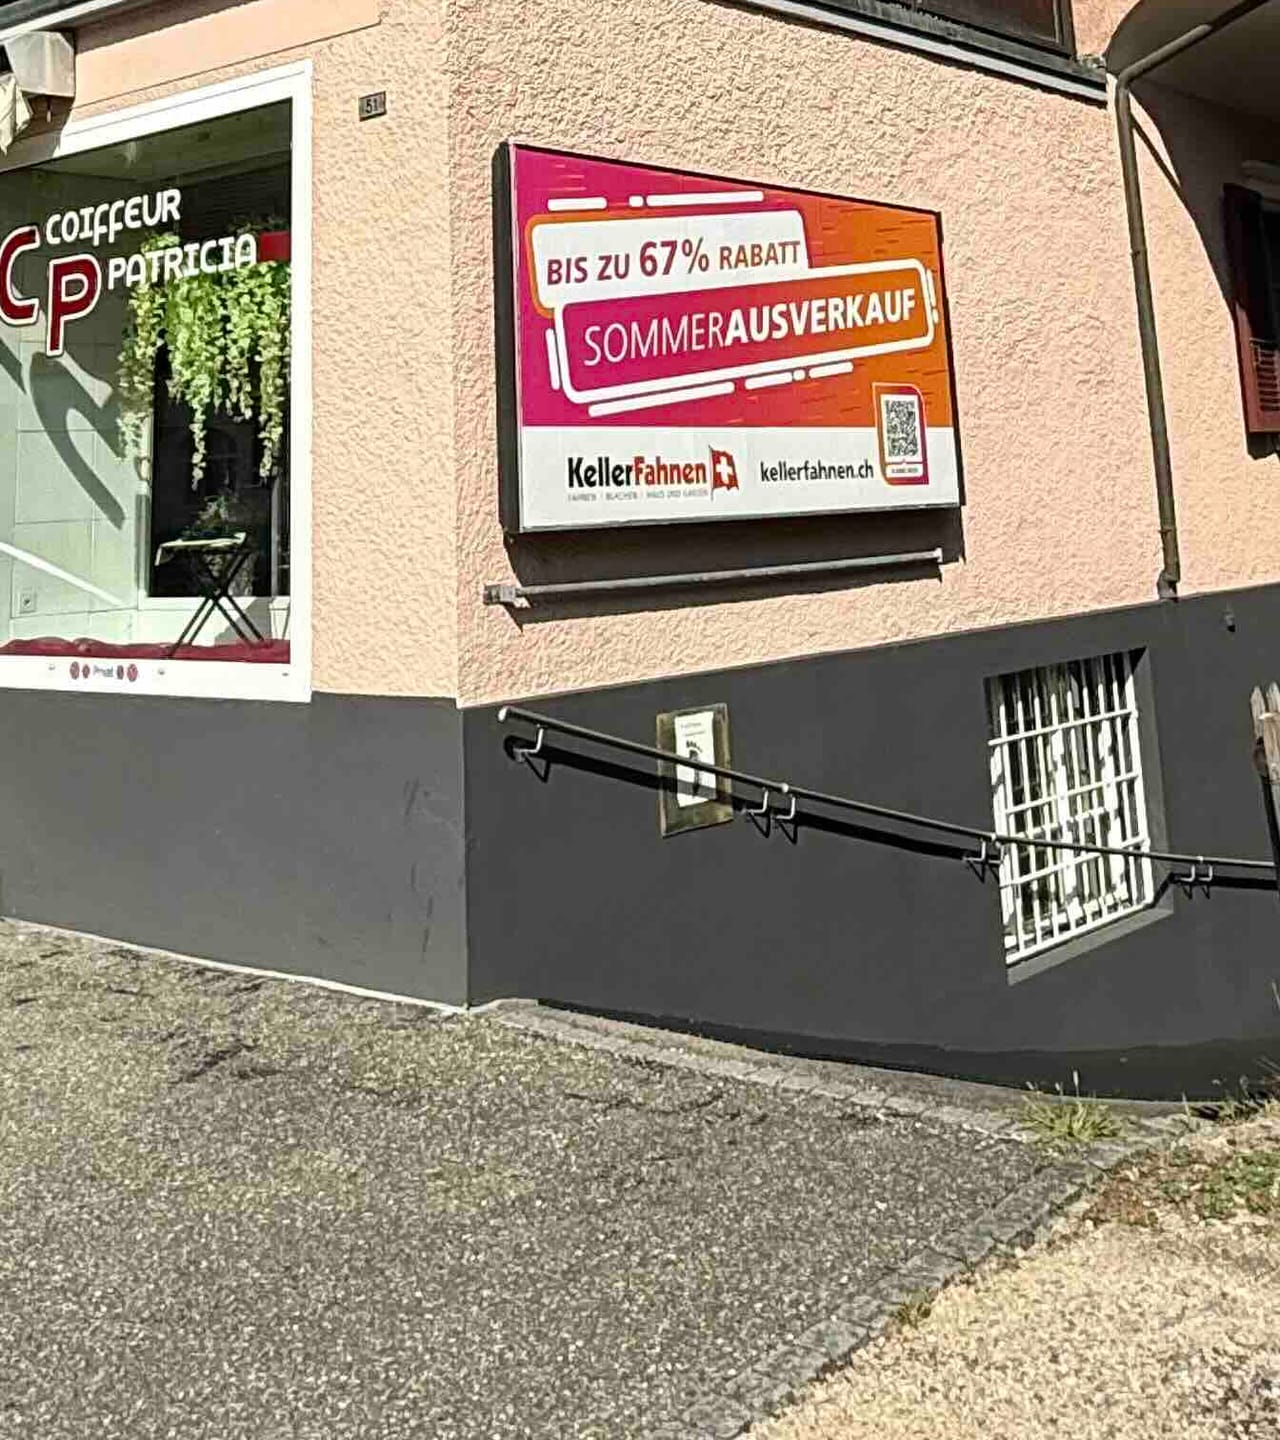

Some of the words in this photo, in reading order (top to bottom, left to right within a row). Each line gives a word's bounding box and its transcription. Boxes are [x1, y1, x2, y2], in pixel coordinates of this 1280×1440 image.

[365, 98, 379, 114] 51
[46, 189, 182, 246] COIFFEUR
[107, 233, 257, 290] PATRICIA
[546, 257, 589, 286] BIS
[597, 254, 631, 282] ZU
[639, 238, 710, 277] 67%
[719, 241, 801, 272] RABATT
[583, 288, 916, 366] SOMMERAUSVERKAUF
[567, 455, 708, 488] KellerFahnen
[760, 457, 875, 484] kellerfahnen.ch
